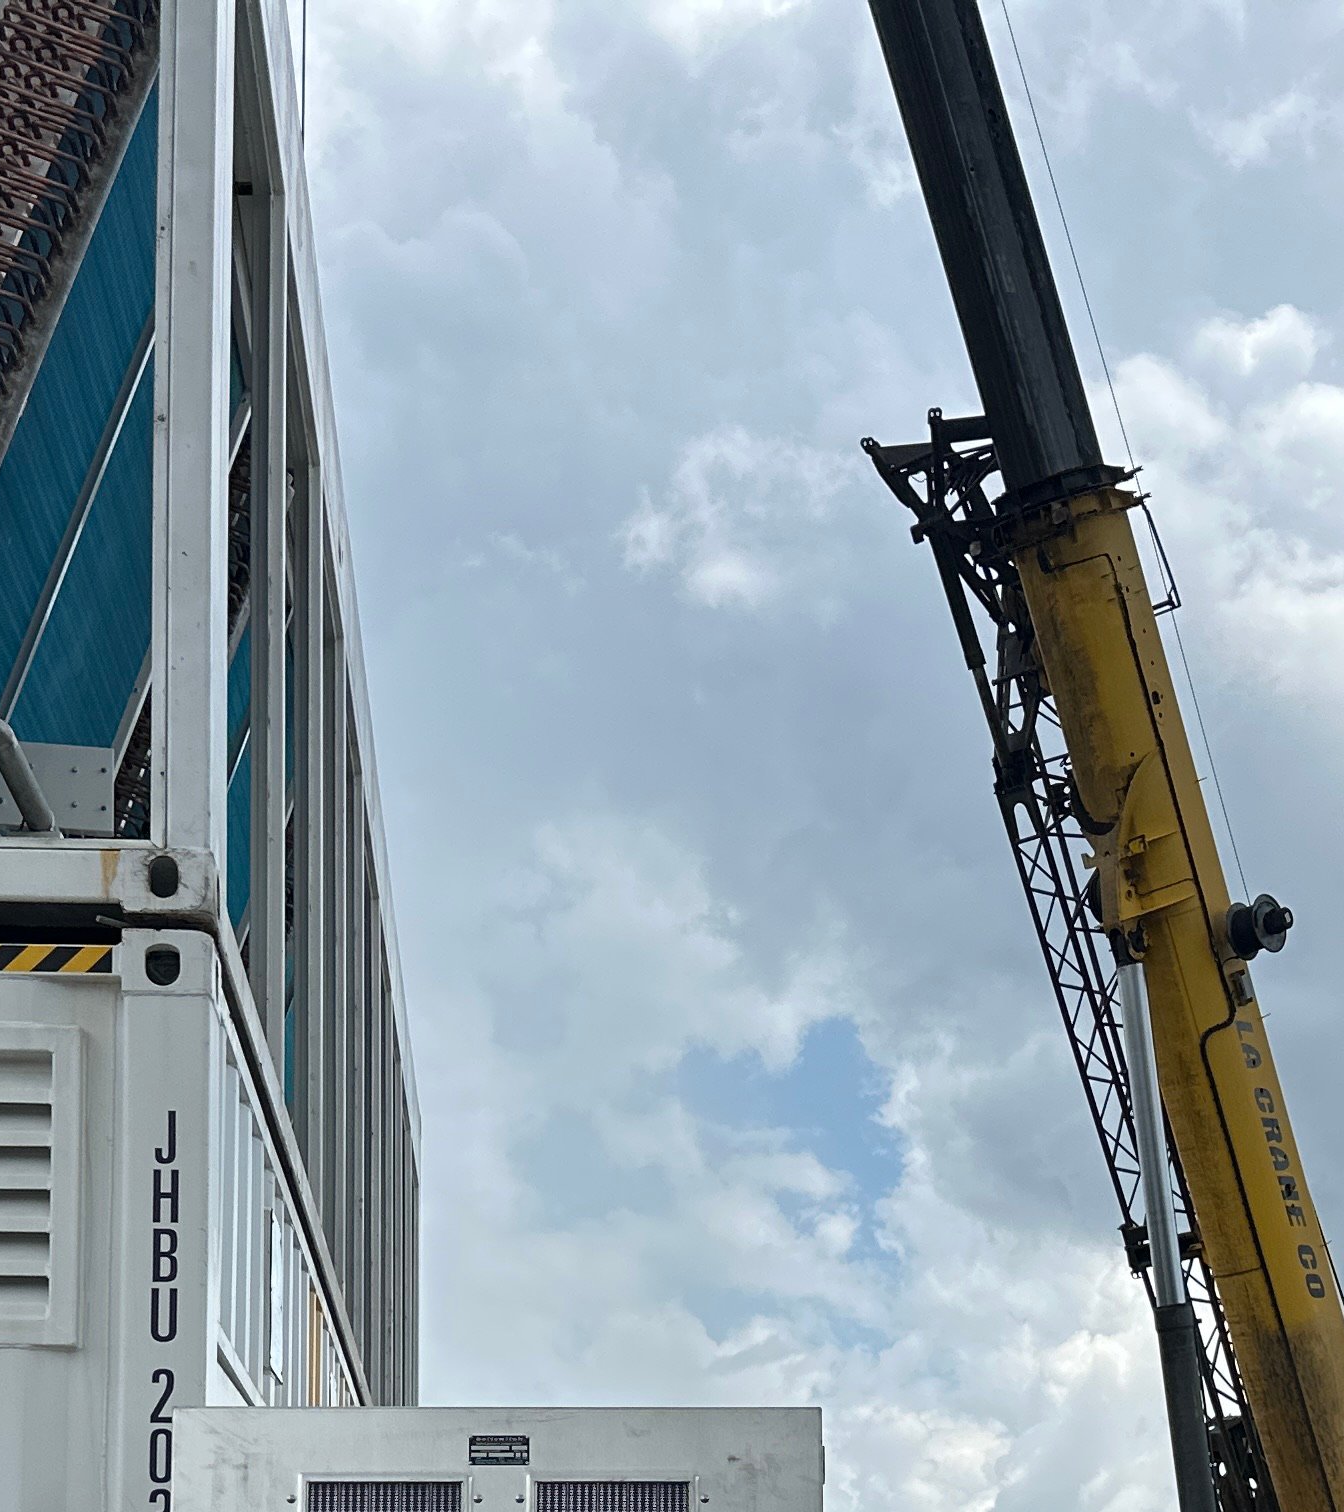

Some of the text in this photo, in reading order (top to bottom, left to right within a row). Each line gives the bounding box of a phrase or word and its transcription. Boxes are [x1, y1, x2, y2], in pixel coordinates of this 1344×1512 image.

[150, 1110, 180, 1343] JHBU
[1254, 1087, 1307, 1228] CRANE
[1298, 1244, 1326, 1299] CO
